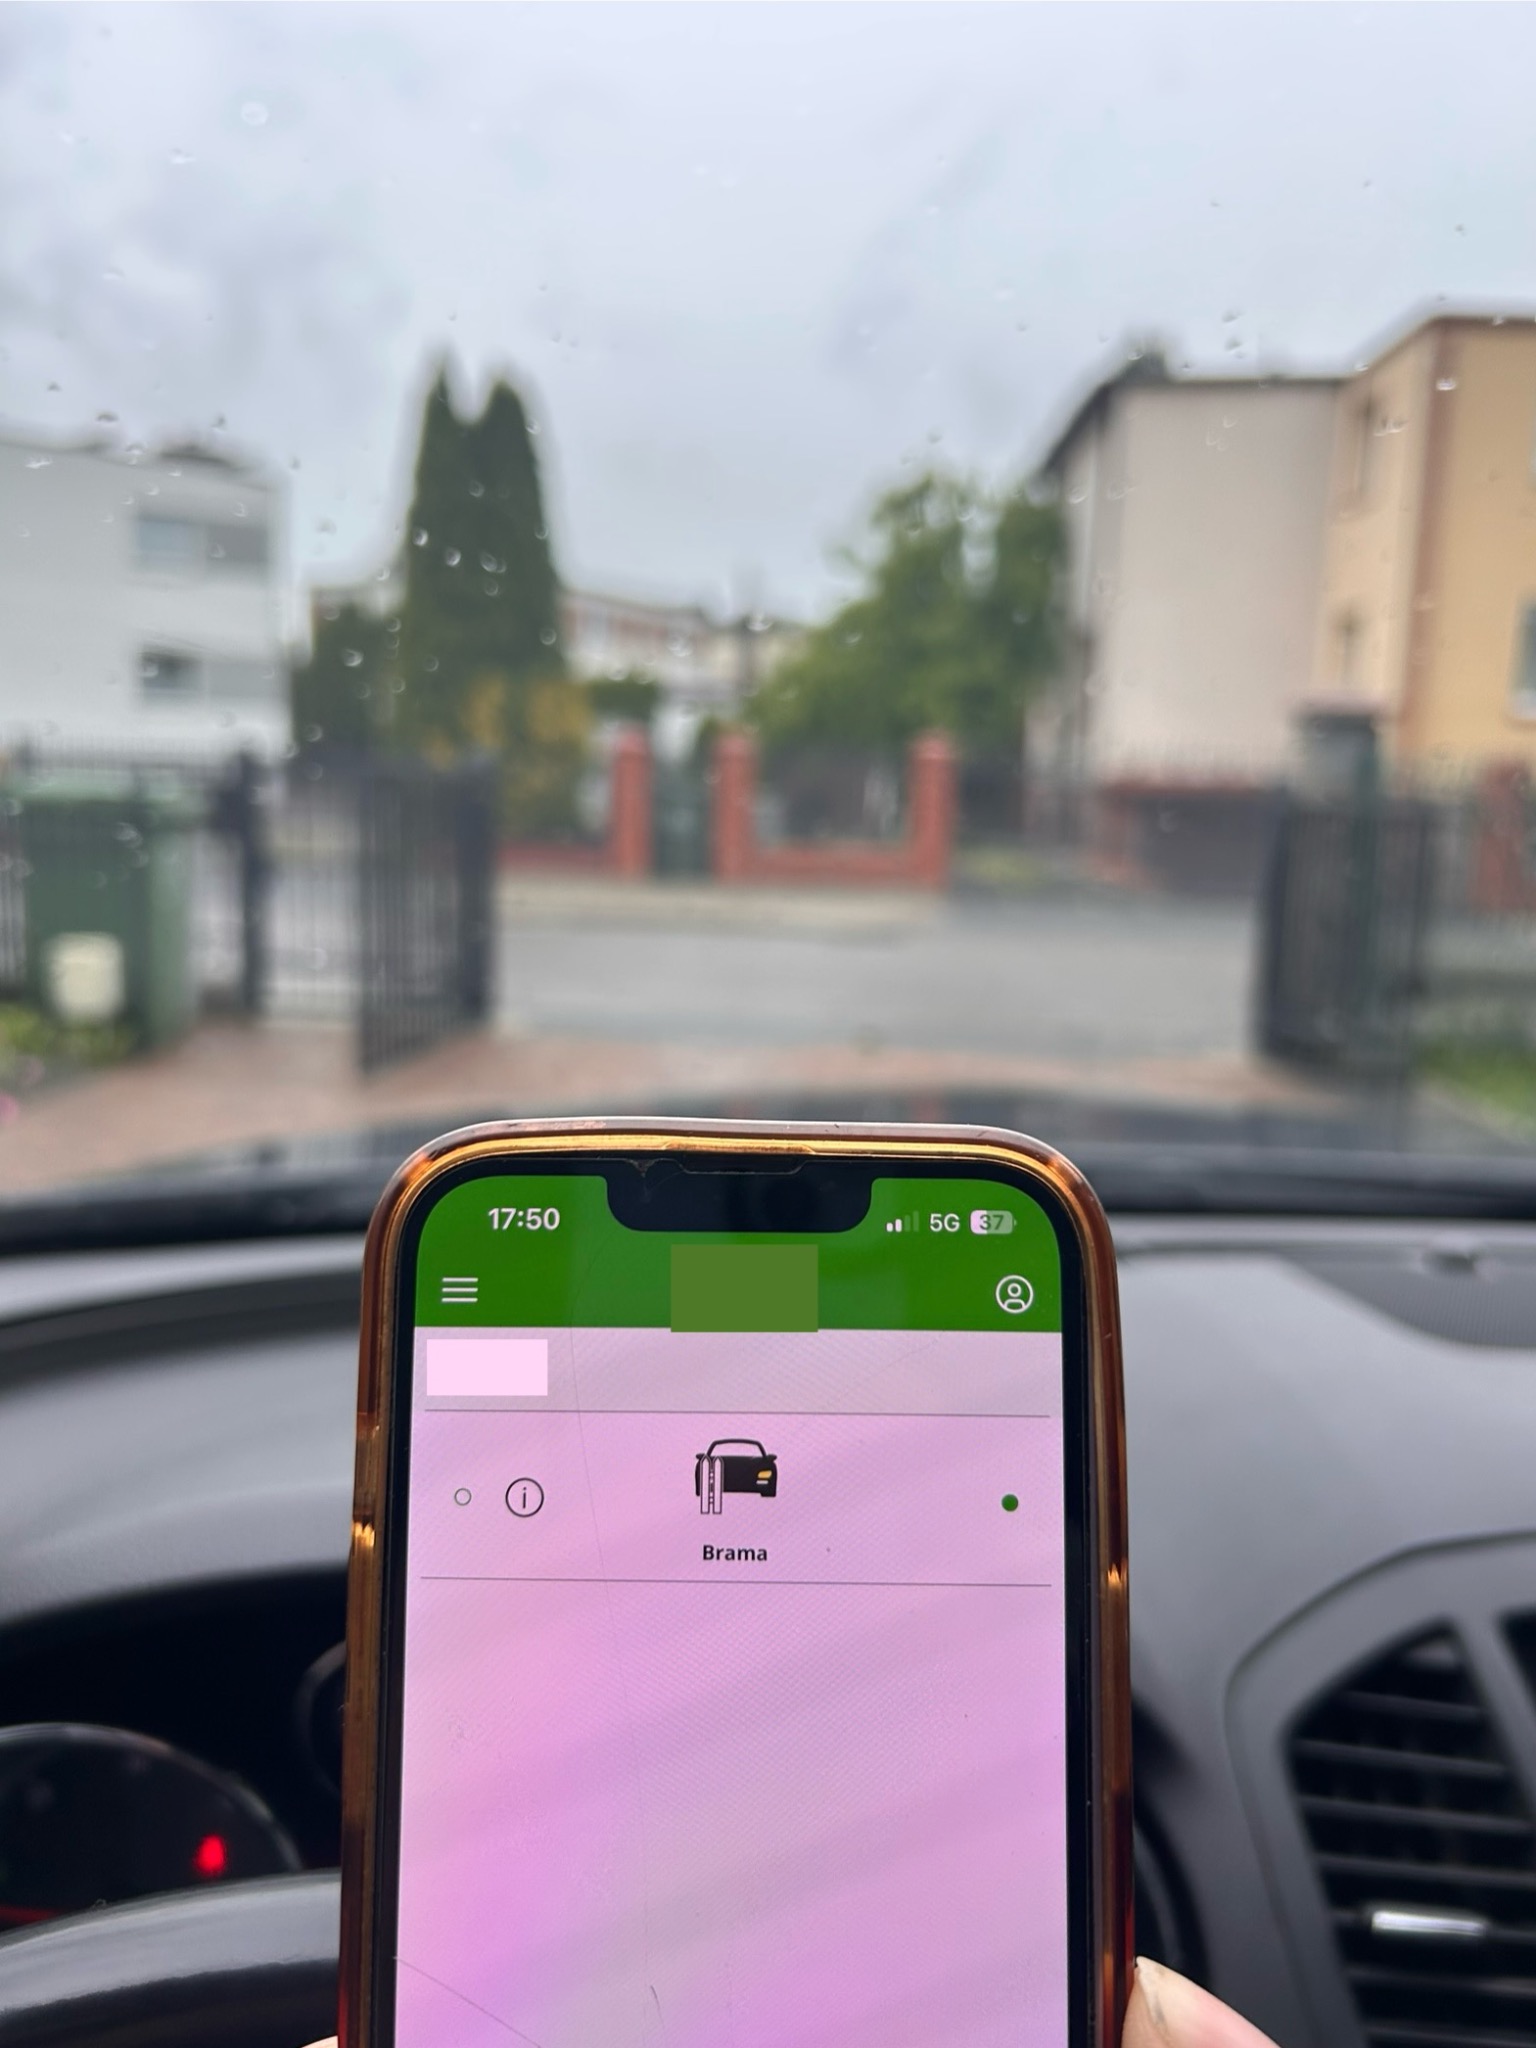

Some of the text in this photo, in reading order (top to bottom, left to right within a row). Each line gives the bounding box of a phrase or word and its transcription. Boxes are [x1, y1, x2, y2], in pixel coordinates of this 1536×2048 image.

[488, 1207, 560, 1230] 17:50
[930, 1213, 1004, 1232] 5G 37
[702, 1544, 768, 1561] Brama
